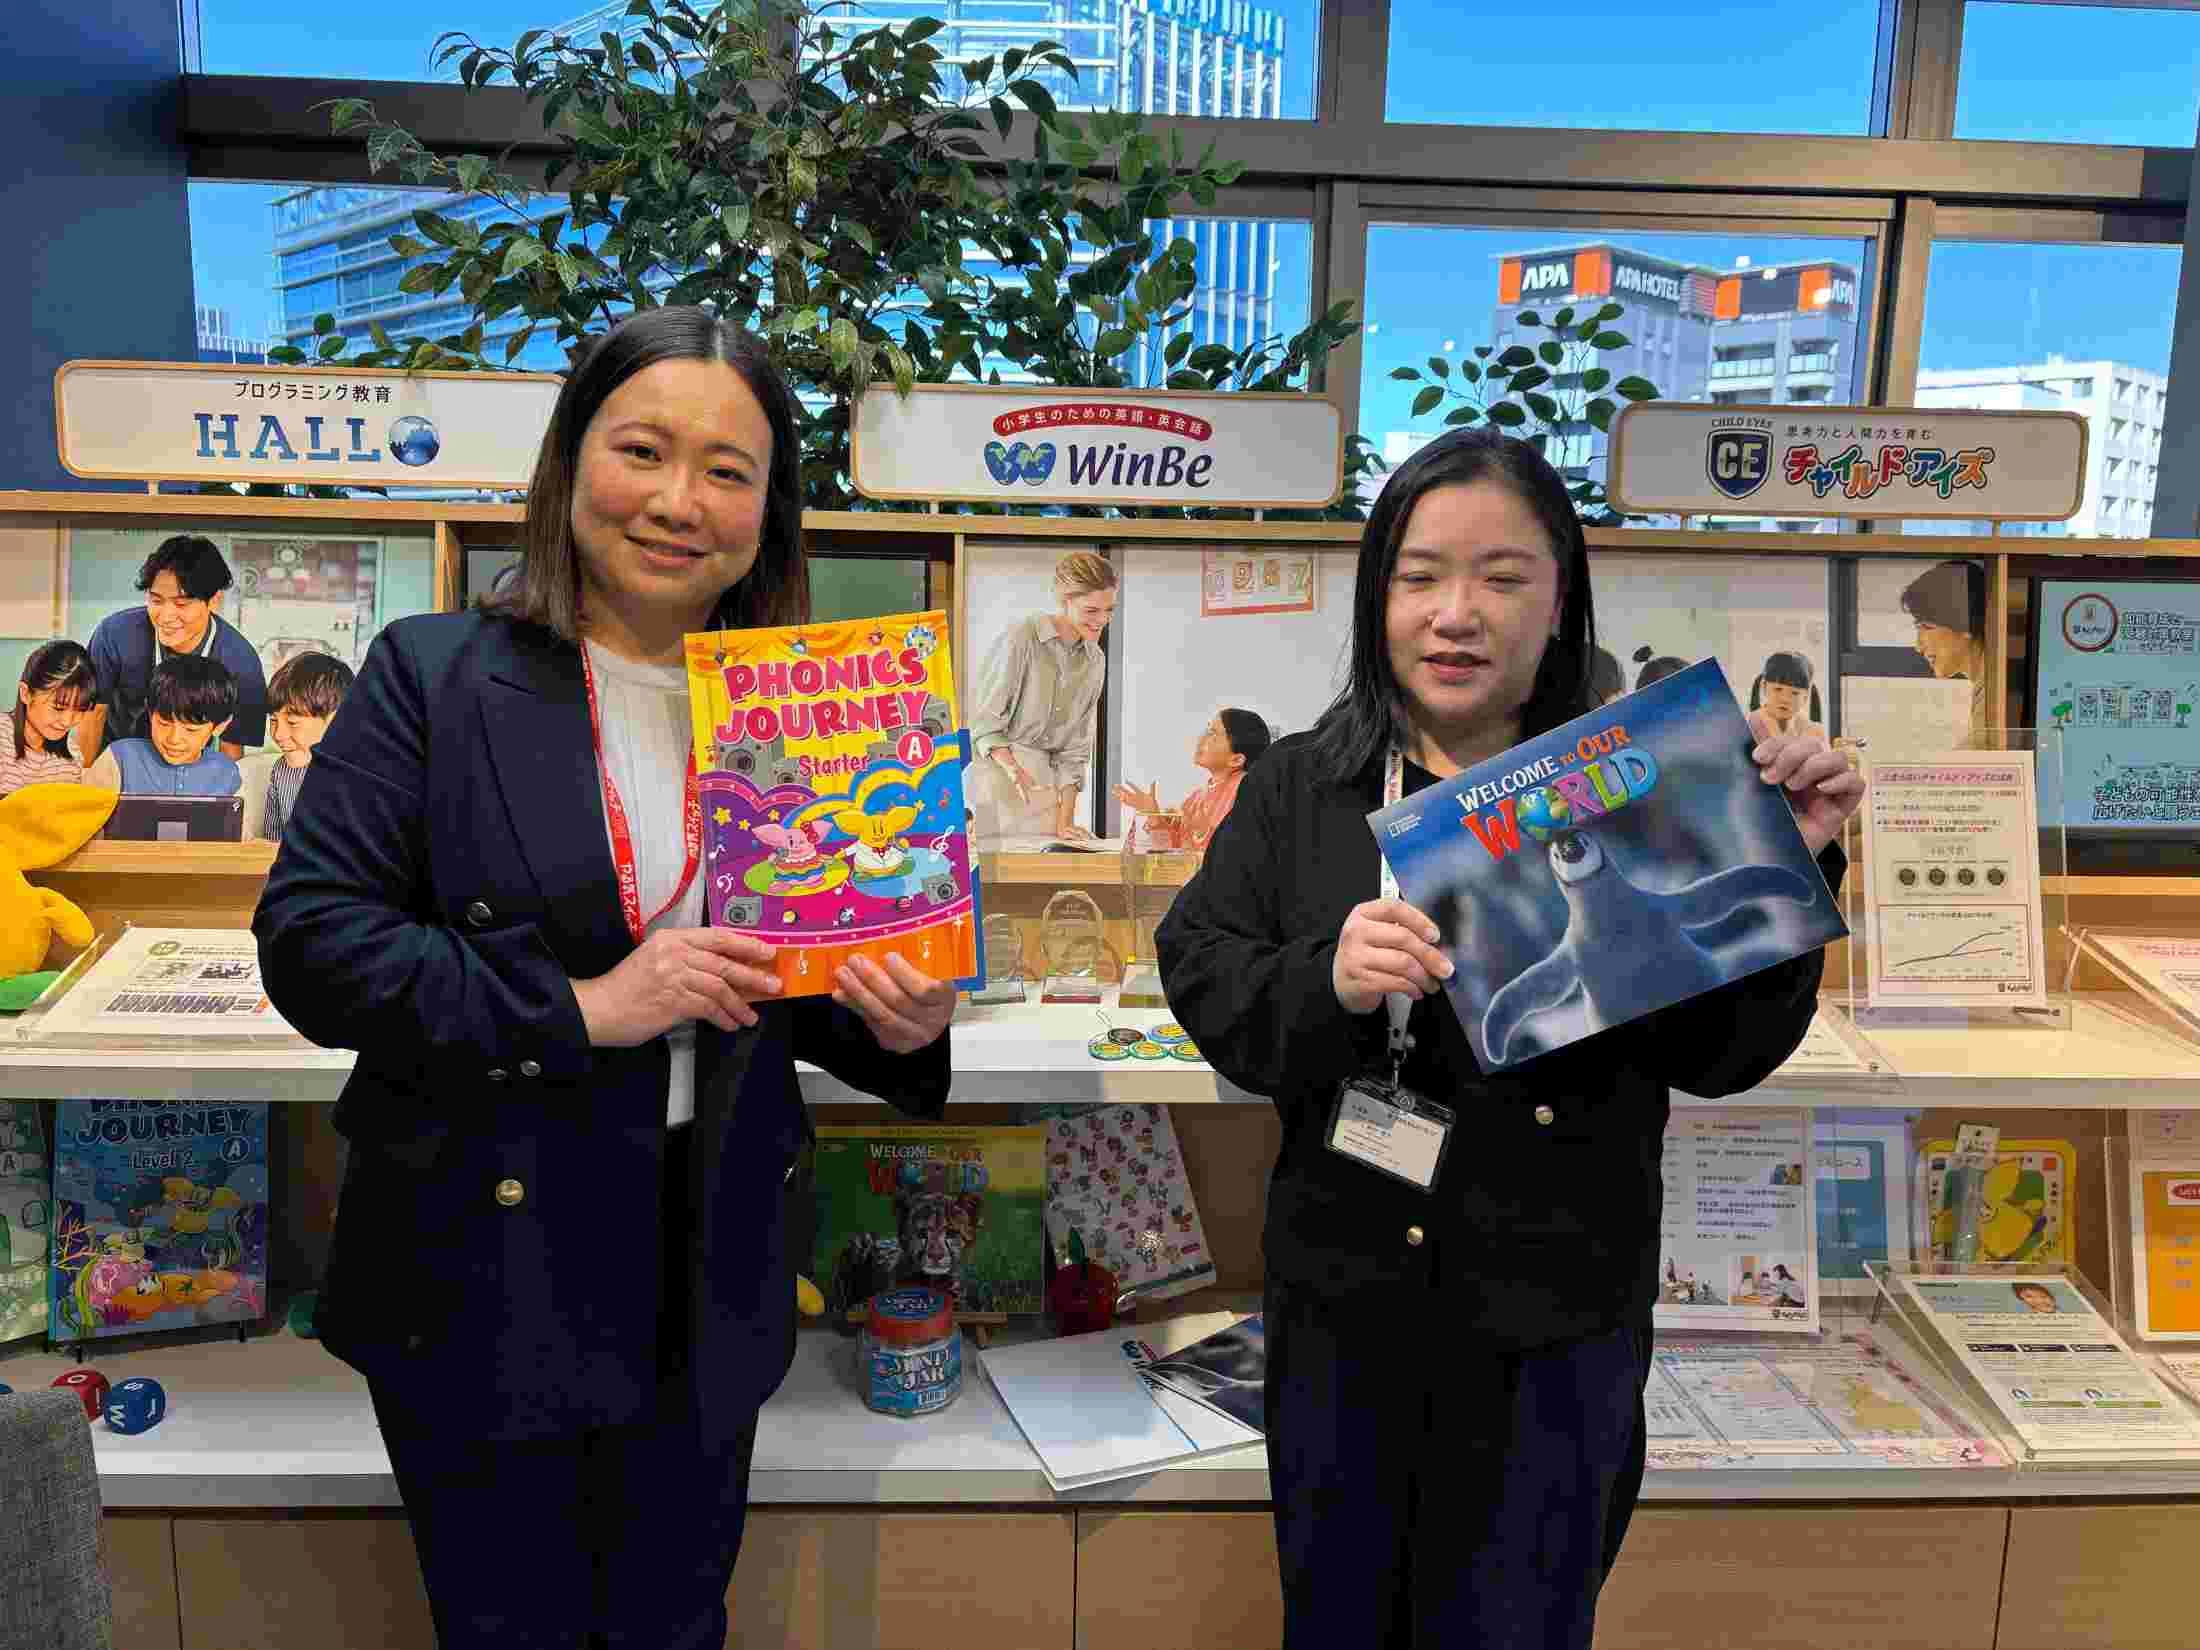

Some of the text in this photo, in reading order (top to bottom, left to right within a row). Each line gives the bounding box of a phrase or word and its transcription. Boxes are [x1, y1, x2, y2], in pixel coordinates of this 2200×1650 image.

[1521, 263, 1569, 291] APA
[1641, 271, 1681, 301] HOTEL
[235, 380, 393, 404] プログラミング教育
[1066, 441, 1214, 488] WinBe
[1717, 440, 1763, 481] CE
[722, 647, 928, 704] PHONICS
[715, 691, 929, 744] JOURNEY
[798, 752, 872, 778] Starter
[1456, 755, 1560, 815] WELCOME
[1576, 724, 1632, 761] OUR
[75, 1108, 252, 1146] JOURNEY
[130, 1149, 177, 1168] Level
[869, 1143, 937, 1160] WELCOME
